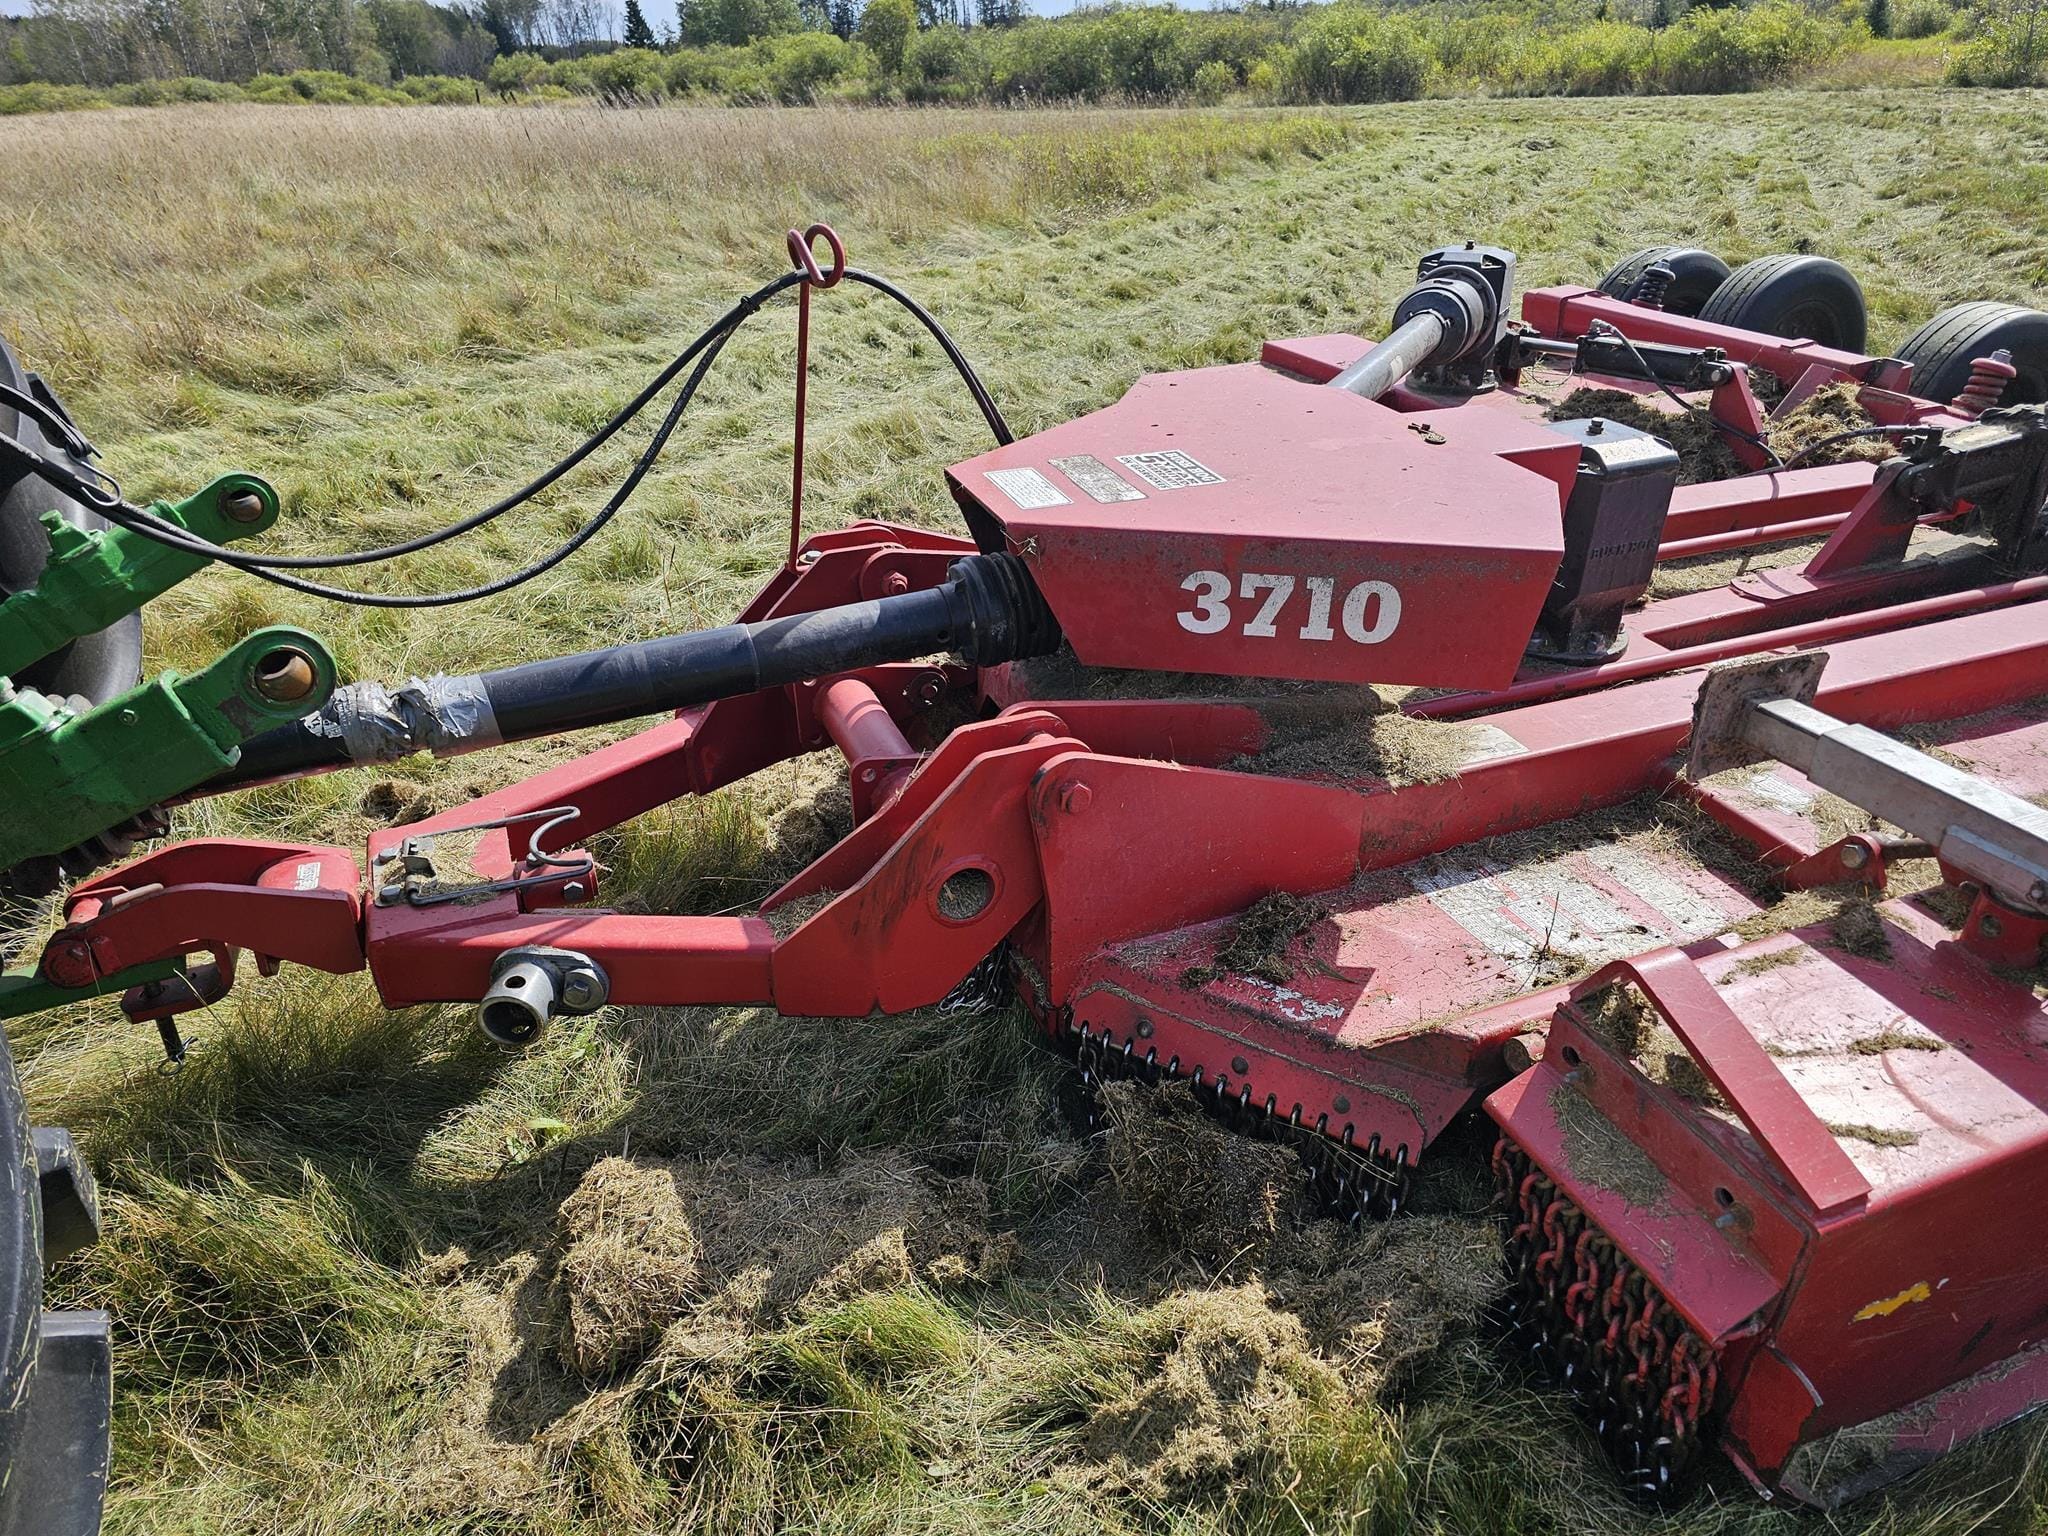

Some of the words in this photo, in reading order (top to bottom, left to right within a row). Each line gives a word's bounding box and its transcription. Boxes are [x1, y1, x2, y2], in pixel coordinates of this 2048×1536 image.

[1135, 455, 1165, 463] 5
[1185, 467, 1217, 481] HOG
[1591, 543, 1627, 560] BUSH
[1176, 569, 1402, 645] 3710
